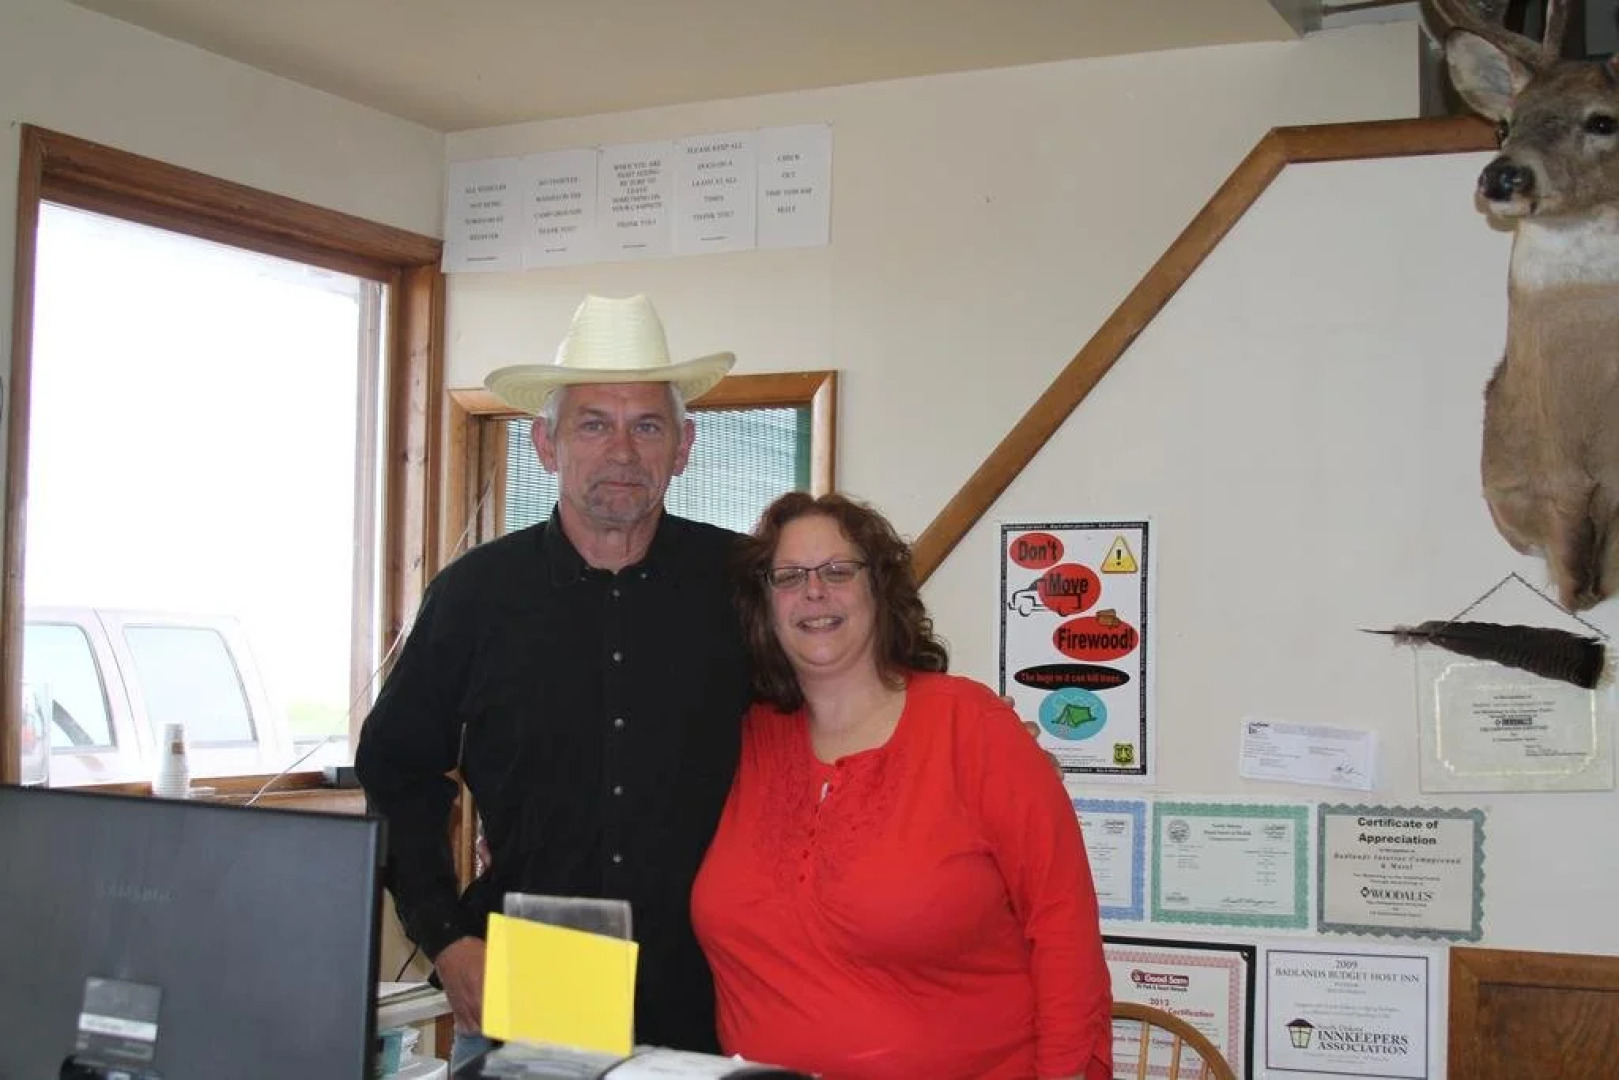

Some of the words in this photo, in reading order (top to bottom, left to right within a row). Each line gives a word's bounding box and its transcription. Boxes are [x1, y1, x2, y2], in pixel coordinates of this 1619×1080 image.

[1018, 540, 1058, 562] Don't
[1046, 576, 1090, 596] Move
[1058, 628, 1134, 650] Firewood!
[1357, 817, 1422, 828] Certificate
[1426, 820, 1438, 830] of
[1358, 832, 1437, 846] Appreciation
[1334, 959, 1358, 969] 2009
[1275, 968, 1326, 979] BADLANDS
[1328, 970, 1368, 982] BUDGET
[1370, 972, 1399, 982] HOST
[1400, 974, 1420, 983] INN
[1318, 1030, 1409, 1046] INNKEEPERS
[1316, 1041, 1408, 1056] ASSOCIATION
